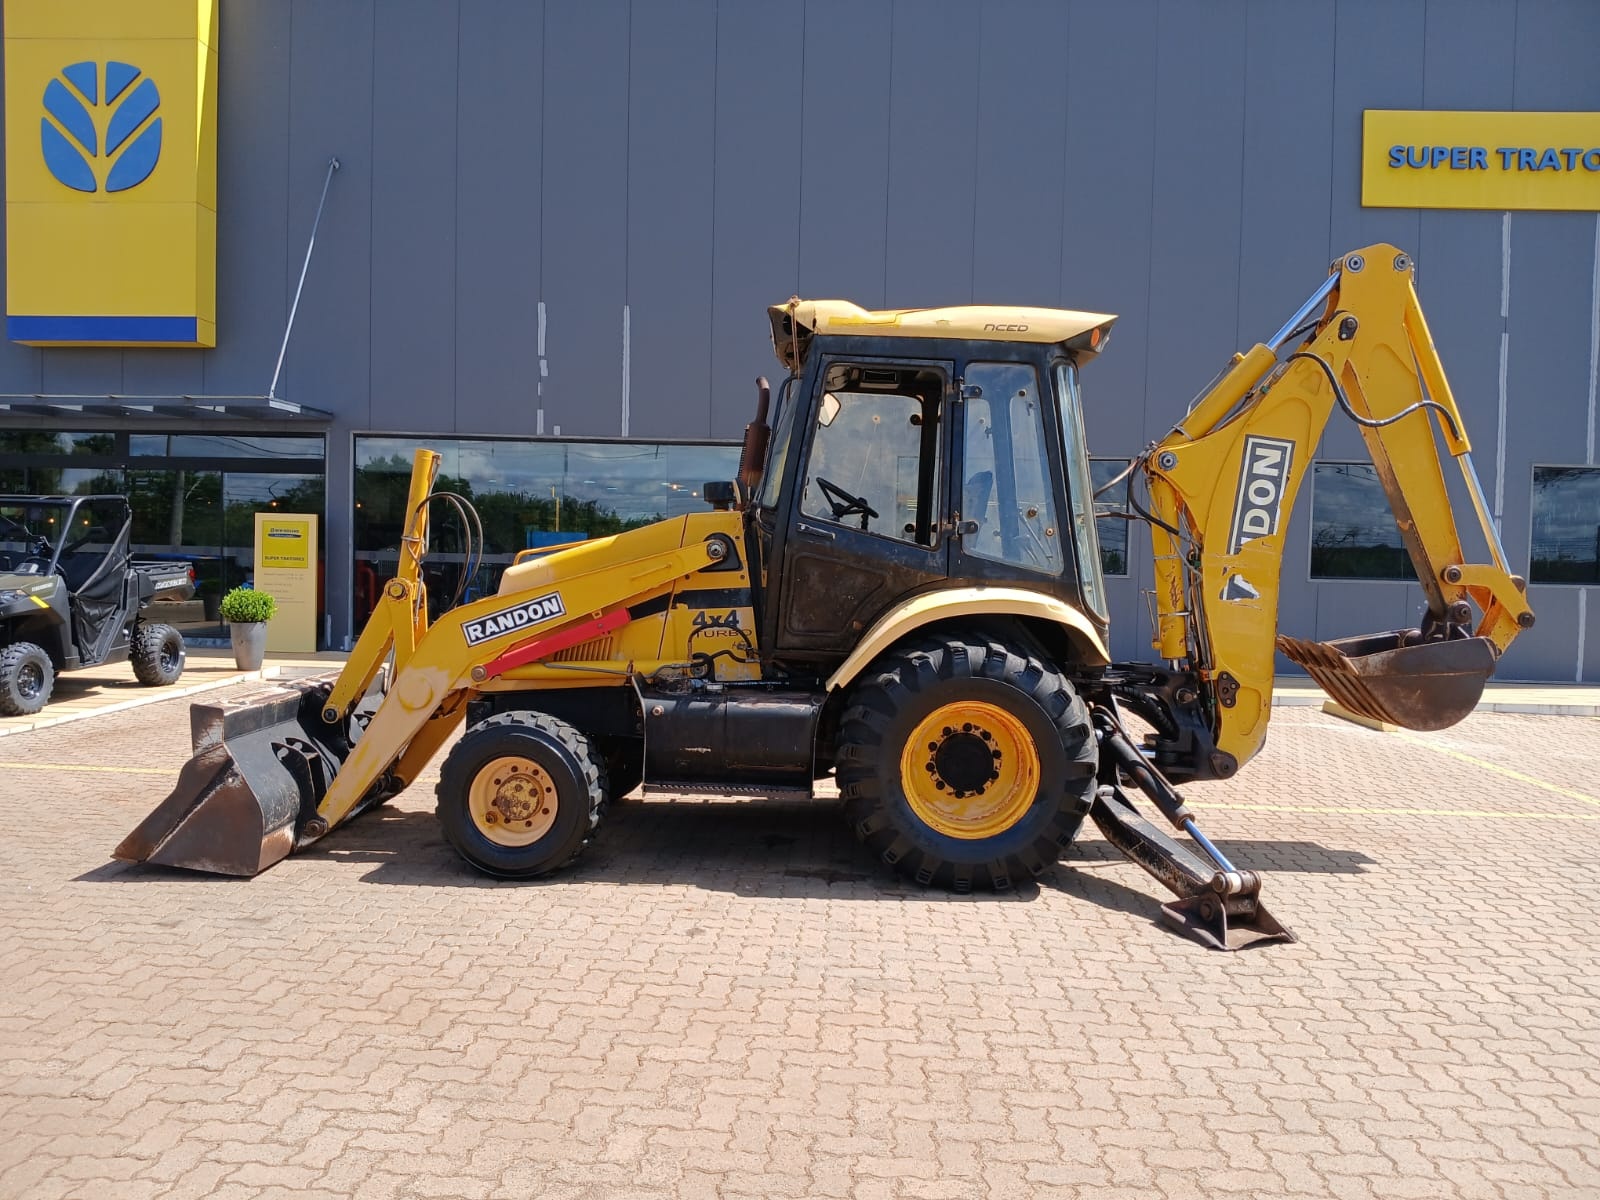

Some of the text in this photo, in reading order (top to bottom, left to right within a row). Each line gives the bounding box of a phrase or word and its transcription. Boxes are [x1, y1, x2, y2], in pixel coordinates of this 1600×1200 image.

[1389, 145, 1600, 171] SUPER TRATO
[467, 598, 560, 641] RANDON
[692, 609, 740, 626] 4x4
[696, 629, 752, 638] TURBO
